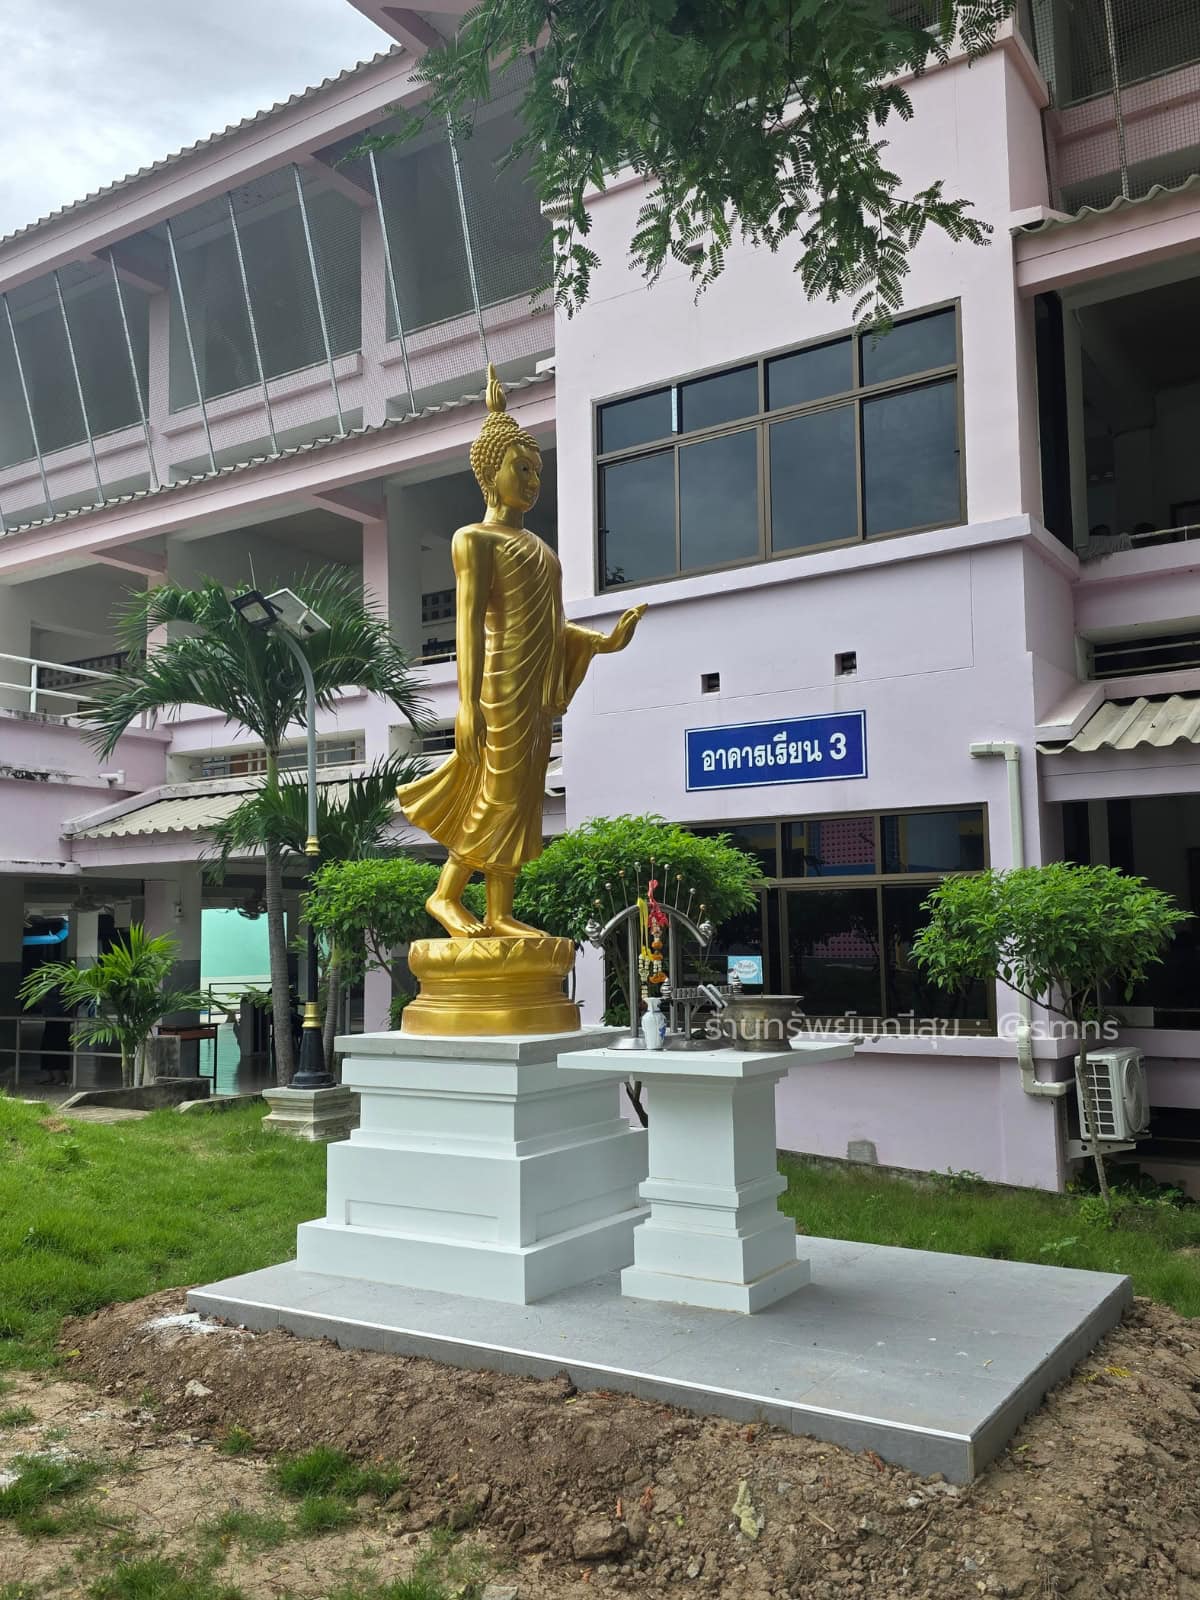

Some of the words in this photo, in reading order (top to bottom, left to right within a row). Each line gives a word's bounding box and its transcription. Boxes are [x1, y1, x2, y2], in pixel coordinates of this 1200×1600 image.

[702, 731, 823, 772] อาคารเรียน
[829, 732, 847, 760] 3
